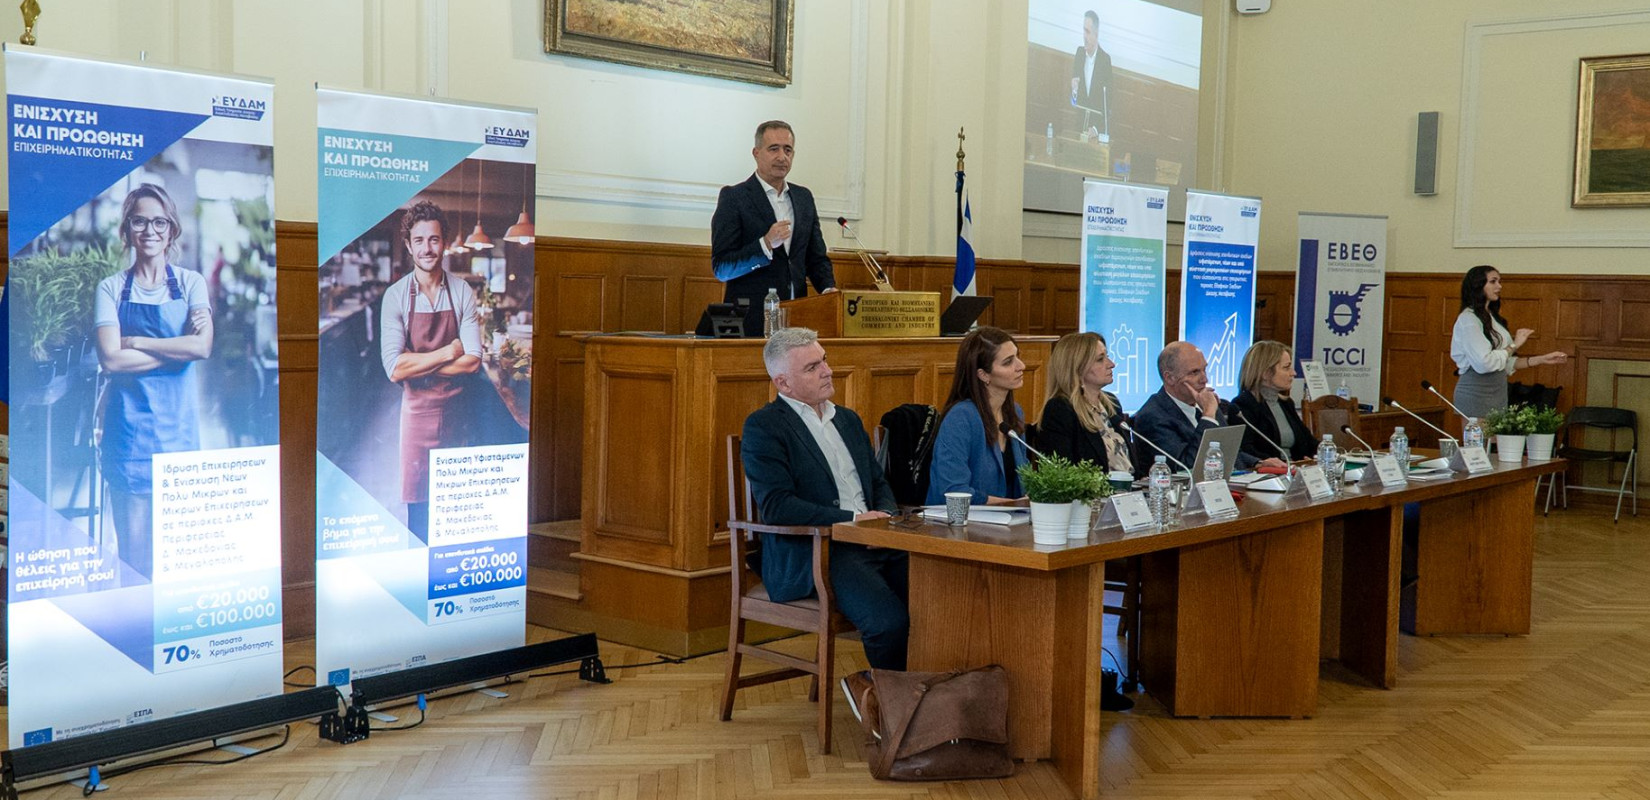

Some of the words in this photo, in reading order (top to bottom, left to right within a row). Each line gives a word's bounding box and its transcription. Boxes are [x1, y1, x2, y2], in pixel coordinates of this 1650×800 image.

[222, 96, 266, 110] ΕΥΔΑΜ
[14, 103, 98, 126] ΕΝΙΣΧΥΣΗ
[14, 124, 42, 140] ΚΑΙ
[46, 126, 144, 148] ΠΡΟΩΘΗΣΗ
[493, 126, 529, 138] ΕΥΔΑΜ
[14, 142, 134, 160] ΕΠΙΧΕΙΡΗΜΑΤΙΚΟΤΗΤΑΣ
[324, 135, 393, 153] ΕΝΙΣΧΥΣΗ
[324, 152, 348, 165] ΚΑΙ
[351, 153, 429, 172] ΠΡΟΩΘΗΣΗ
[324, 168, 420, 183] ΕΠΙΧΕΙΡΗΜΑΤΙΚΟΤΗΤΑΣ
[1328, 242, 1377, 261] ΕΒΕΘ
[1323, 348, 1365, 365] TCCI
[162, 479, 170, 488] &
[323, 516, 336, 525] Το
[323, 528, 349, 541] βήμα
[15, 552, 24, 563] Η
[28, 549, 70, 562] ώθηση
[74, 546, 97, 556] που
[460, 552, 517, 571] €20.000
[16, 564, 57, 577] θέλεις
[60, 562, 80, 575] για
[83, 558, 104, 571] την
[460, 566, 522, 587] €100.000
[16, 573, 85, 592] επιχείρησή
[88, 568, 114, 582] σου!
[196, 585, 270, 610] €20.000
[196, 602, 276, 628] €100.000
[434, 601, 463, 617] 70%
[162, 644, 202, 665] 70%
